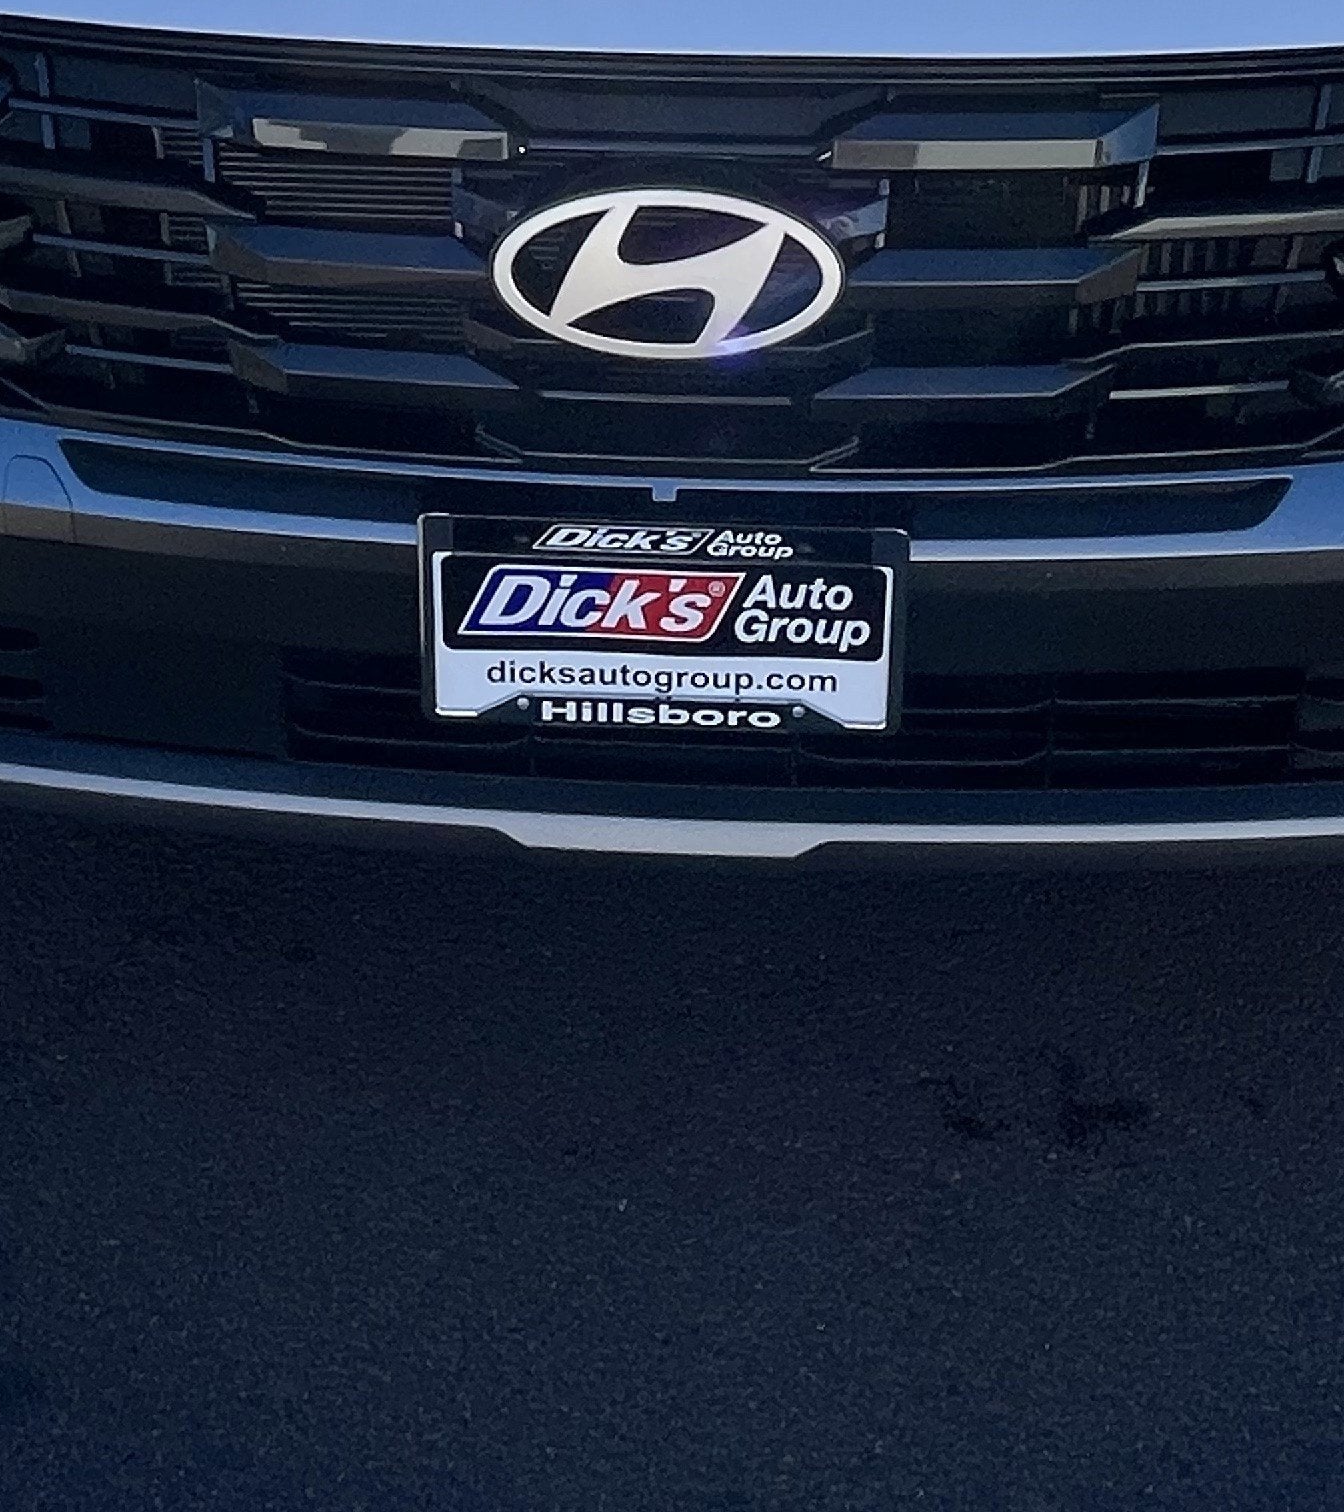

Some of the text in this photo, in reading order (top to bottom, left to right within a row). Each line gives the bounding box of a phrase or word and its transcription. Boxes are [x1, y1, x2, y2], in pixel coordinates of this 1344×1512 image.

[546, 529, 694, 552] Dick's
[707, 543, 794, 560] Group
[711, 531, 782, 546] Auto
[478, 574, 710, 633] Dick's
[742, 574, 854, 611] Auto
[734, 610, 871, 651] Group
[486, 661, 838, 695] dicksautogroup.com
[541, 701, 782, 728] Hillsboro
